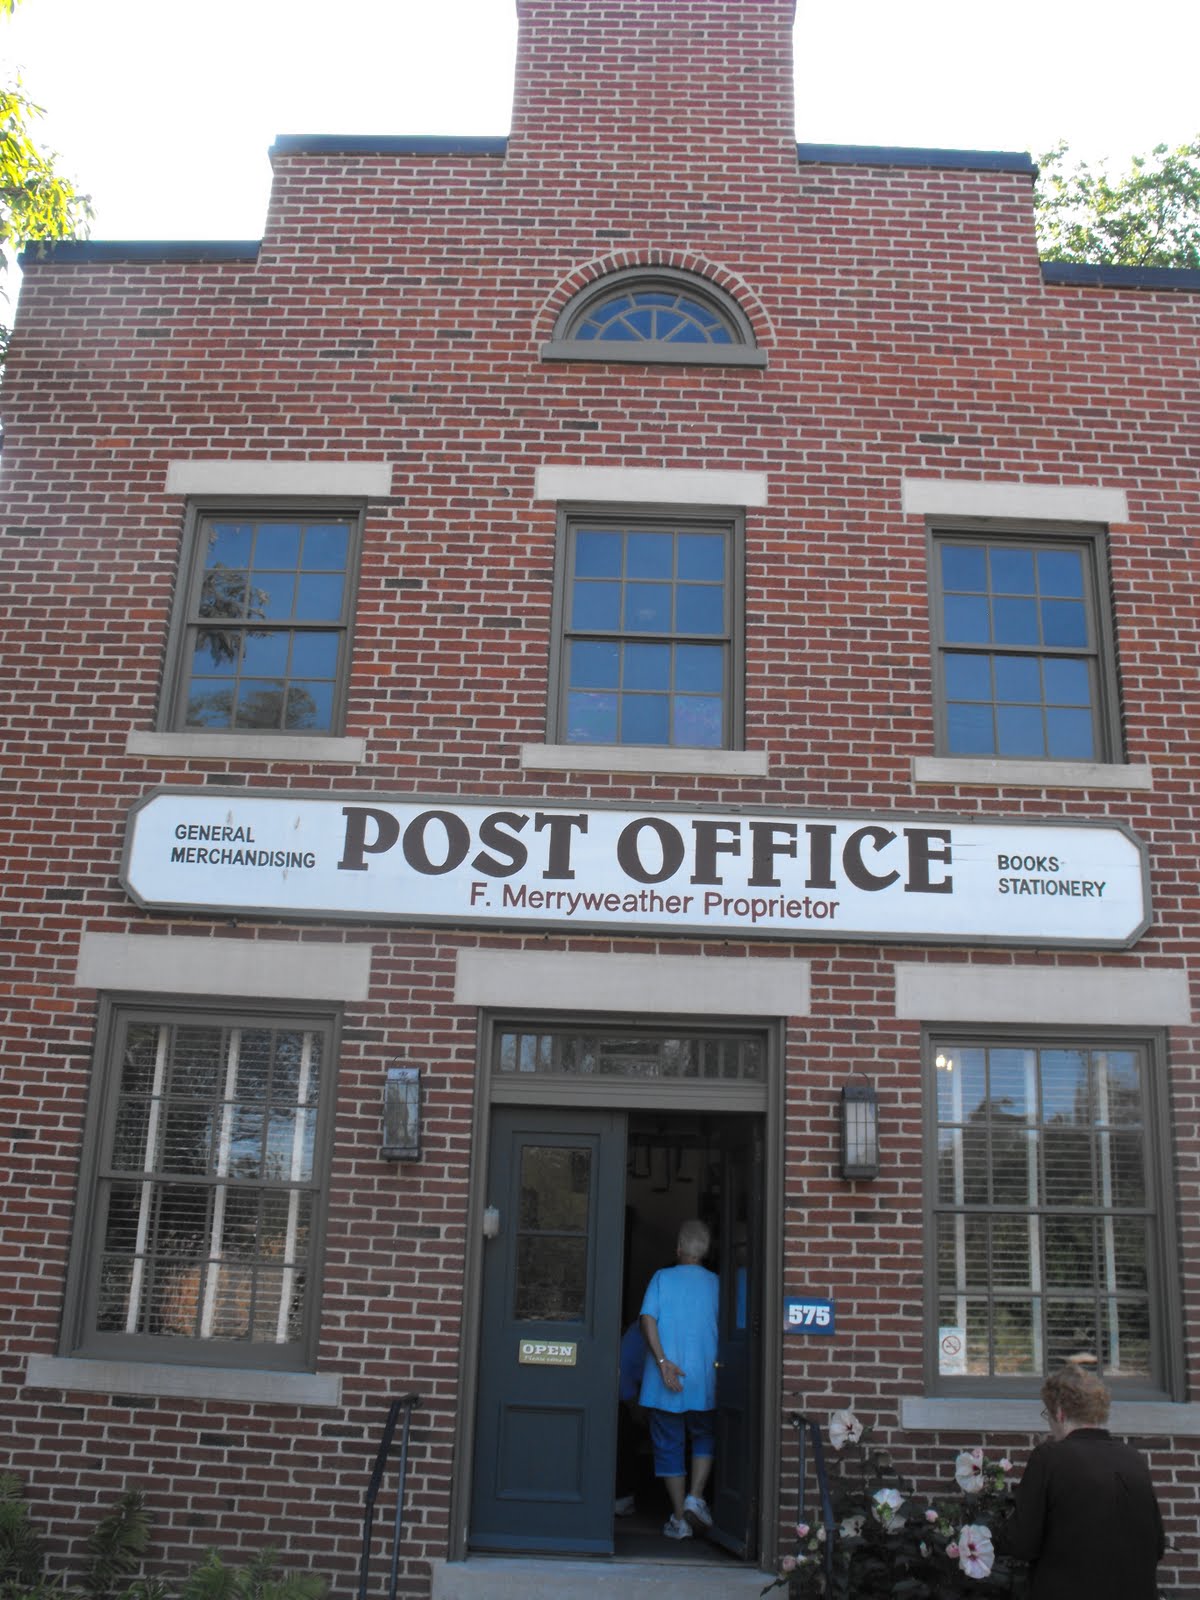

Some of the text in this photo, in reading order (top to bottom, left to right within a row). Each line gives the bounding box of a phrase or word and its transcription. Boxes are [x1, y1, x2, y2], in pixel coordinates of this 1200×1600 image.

[174, 823, 255, 843] GENERAL
[170, 846, 316, 869] MERCHANDISING
[337, 806, 954, 894] POST OFFICE
[997, 854, 1060, 873] BOOKS
[997, 876, 1106, 898] STATIONERY
[470, 882, 840, 923] F. Merryweather Proprietor
[788, 1304, 831, 1326] 575
[522, 1343, 573, 1356] OPEN
